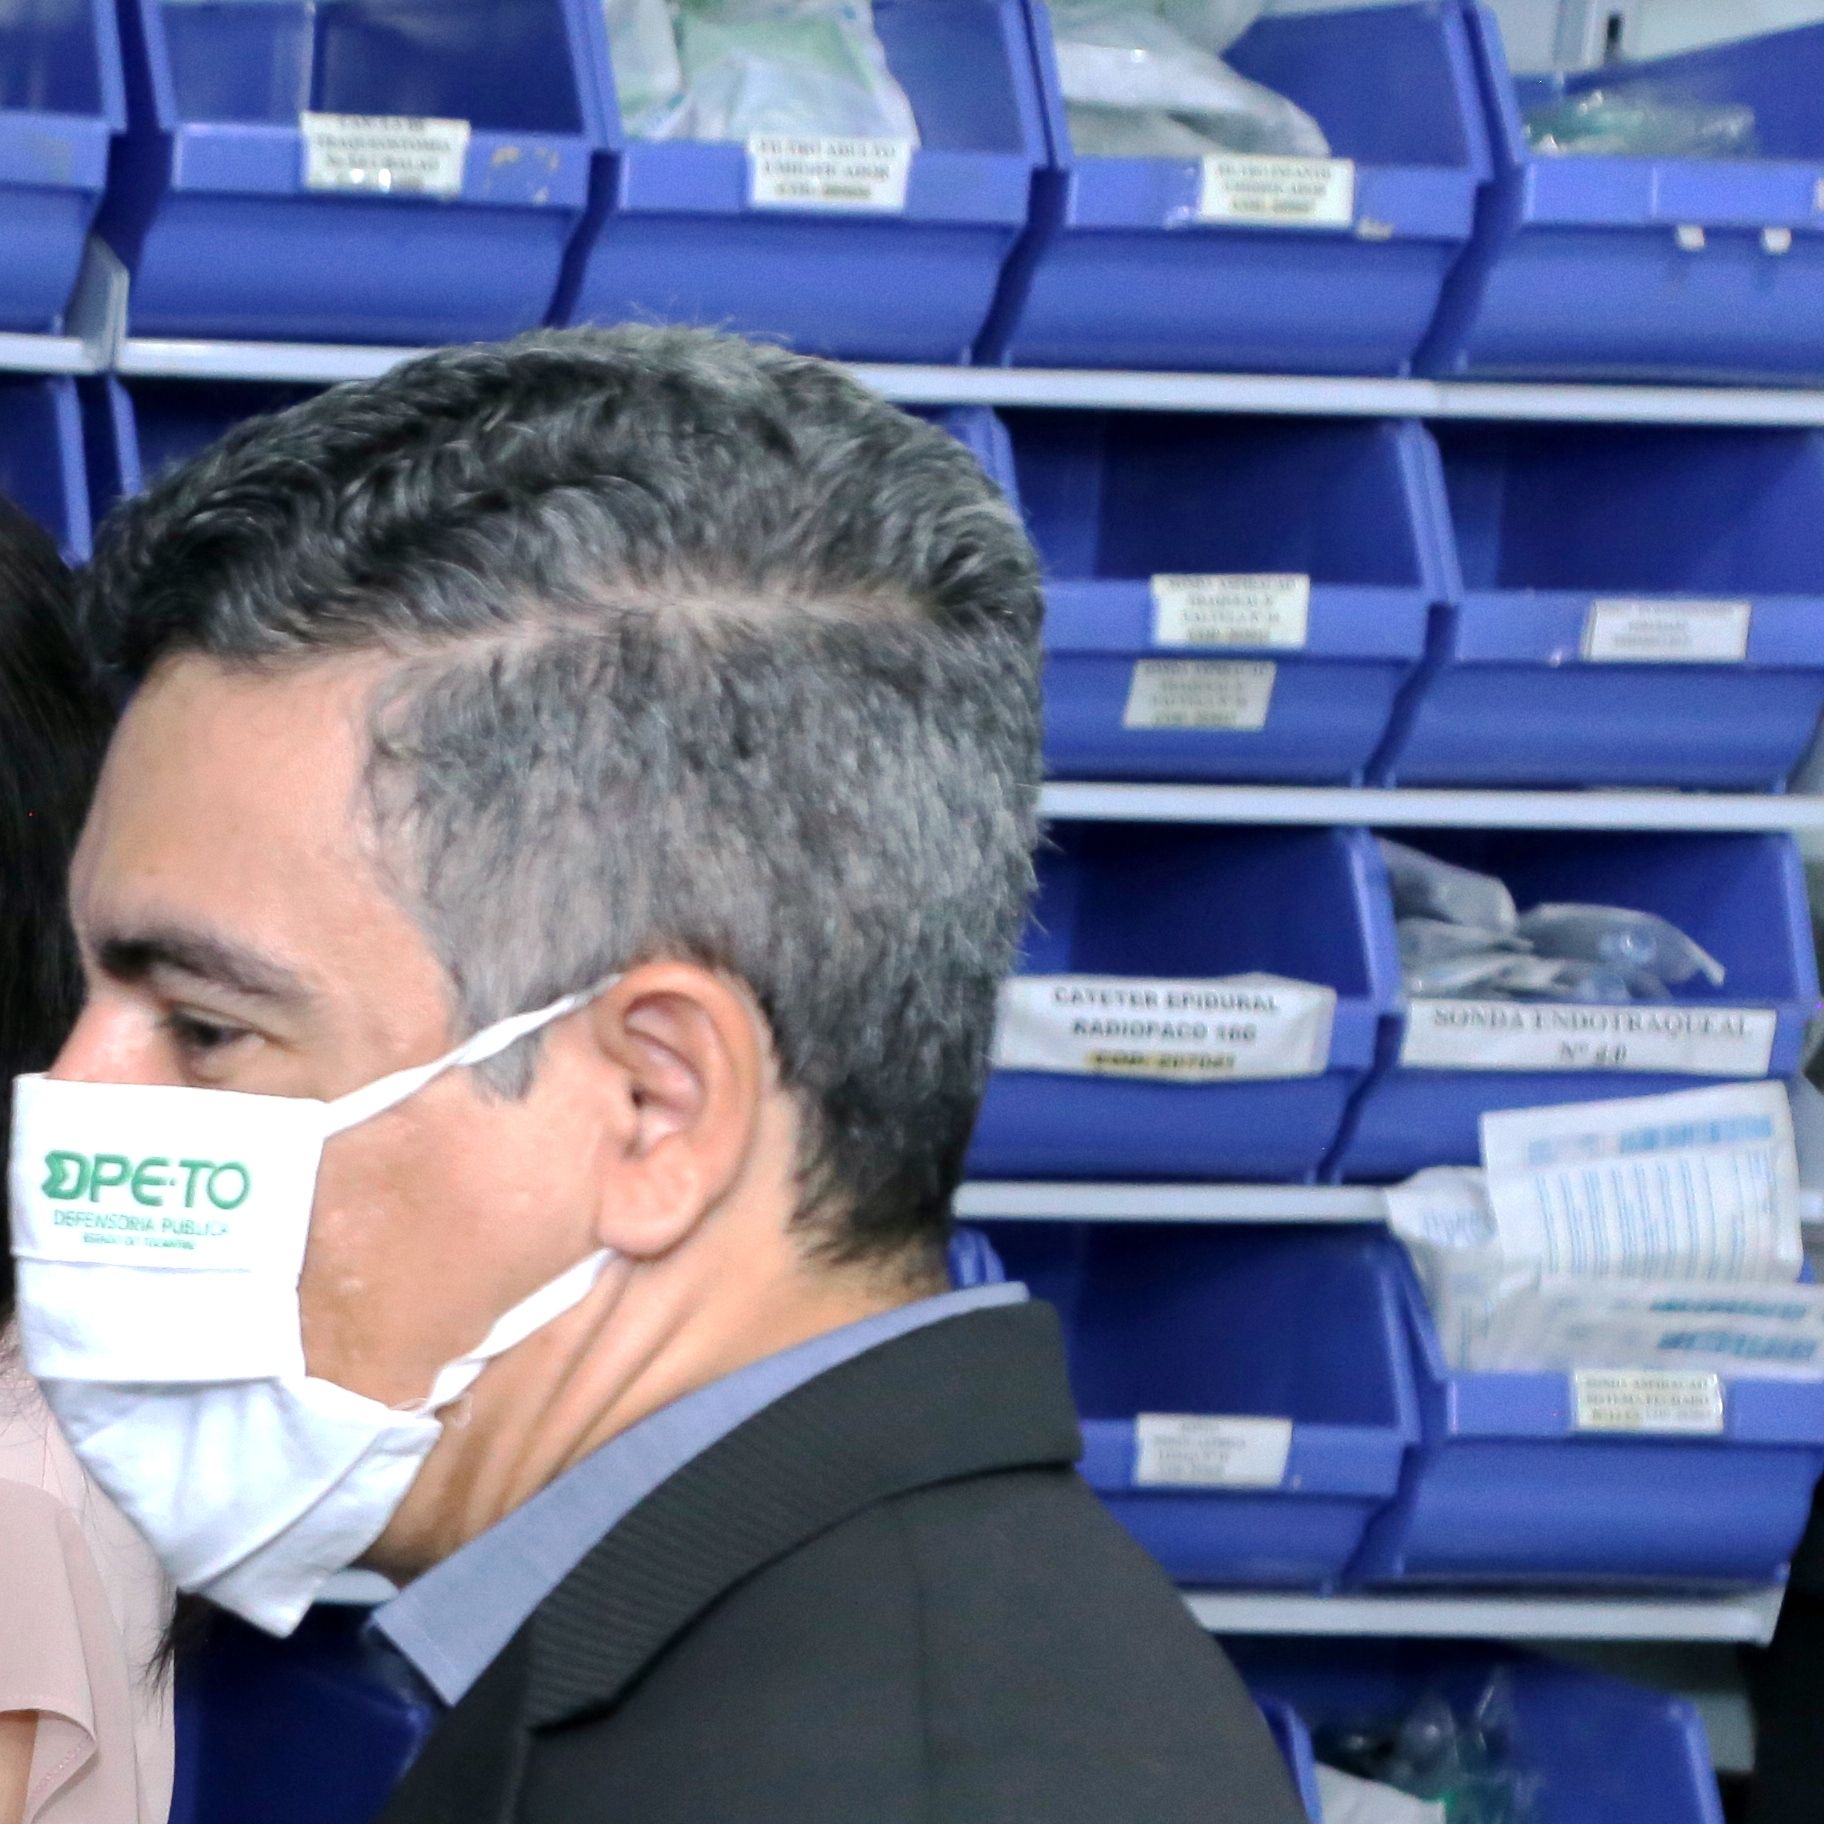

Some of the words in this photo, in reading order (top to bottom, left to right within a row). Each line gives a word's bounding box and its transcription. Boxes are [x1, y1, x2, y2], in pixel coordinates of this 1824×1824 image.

[1055, 984, 1160, 1010] CATETER
[1165, 989, 1282, 1015] EPIDURAL
[1071, 1016, 1210, 1041] RADIOPACO
[1432, 1005, 1525, 1031] SONDA
[1530, 1006, 1748, 1043] ENDOTRAQUEAL
